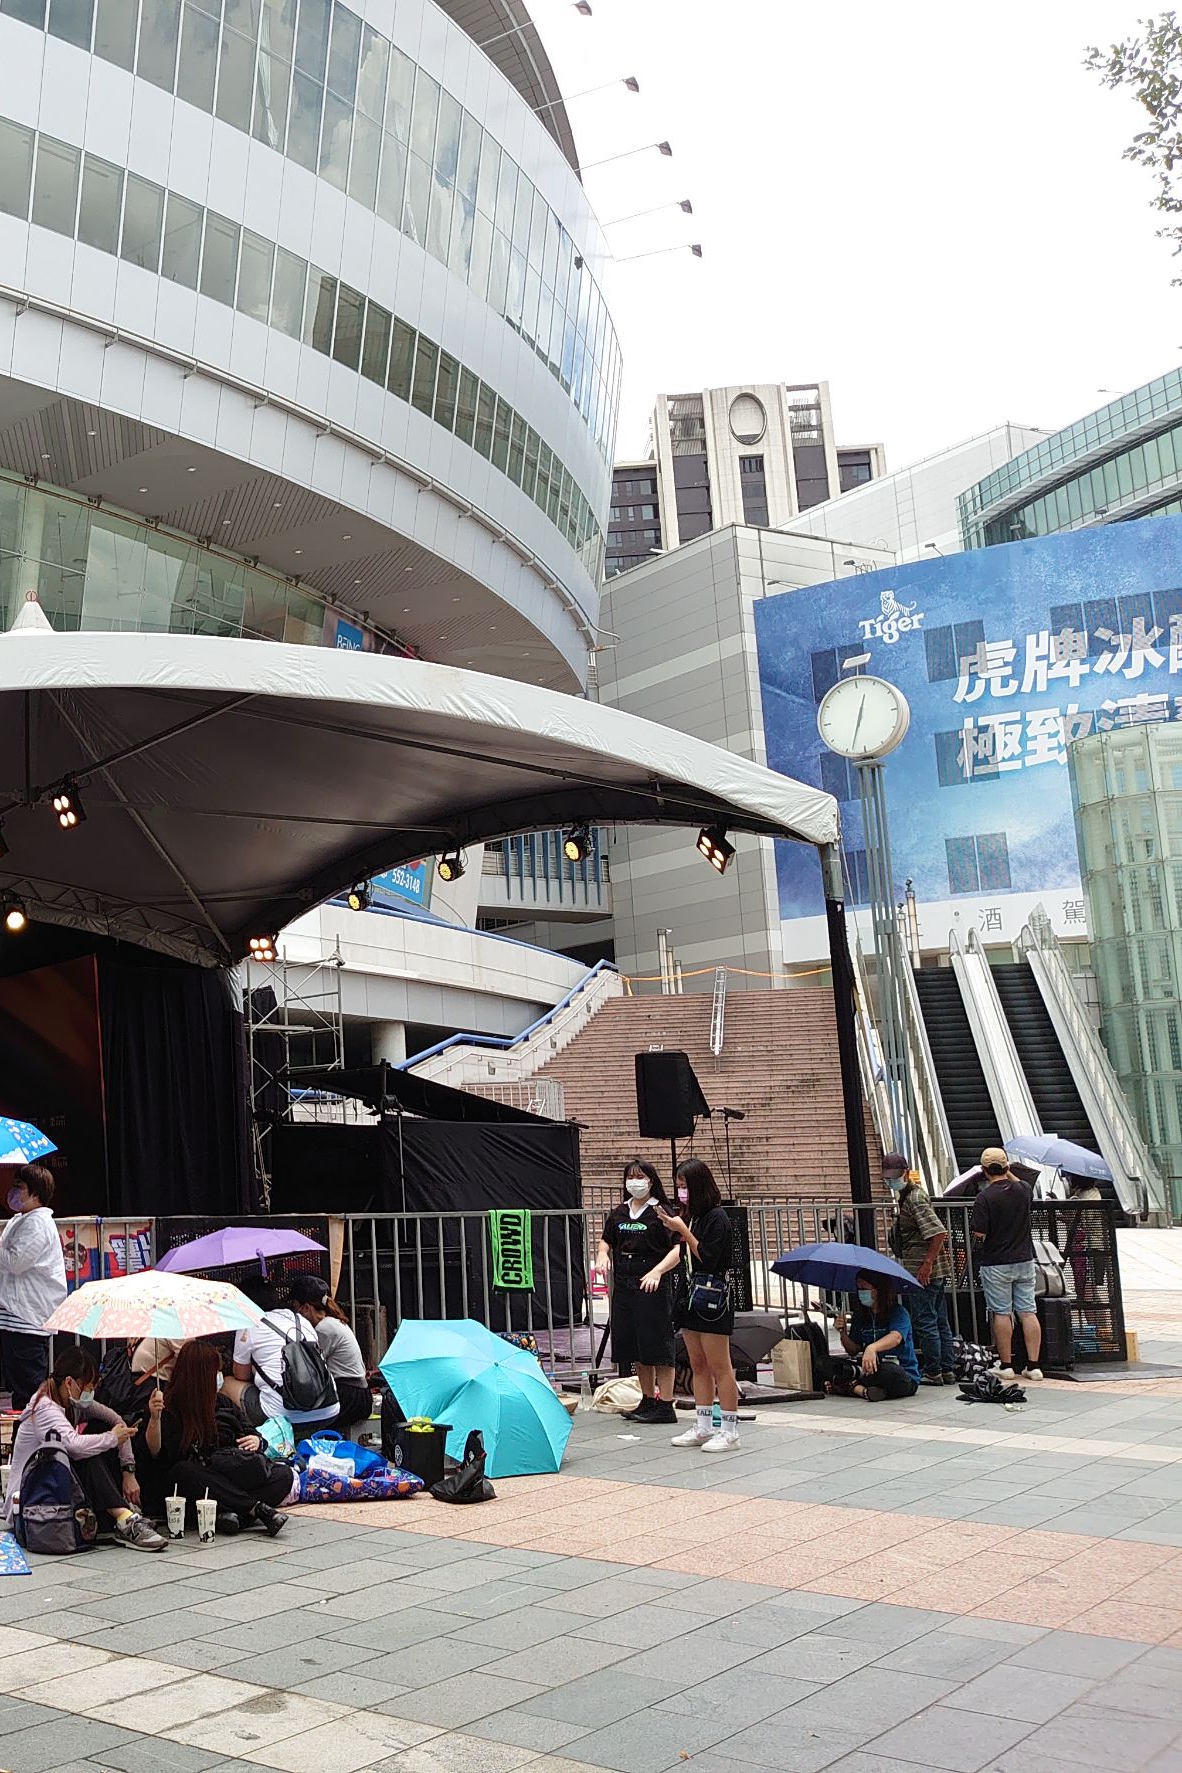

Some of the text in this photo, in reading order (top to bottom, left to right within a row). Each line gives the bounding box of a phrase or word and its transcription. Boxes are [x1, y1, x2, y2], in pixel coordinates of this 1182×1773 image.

[859, 611, 925, 644] Tiger
[952, 614, 1182, 704] 虎牌冰
[499, 1213, 522, 1285] CROWD
